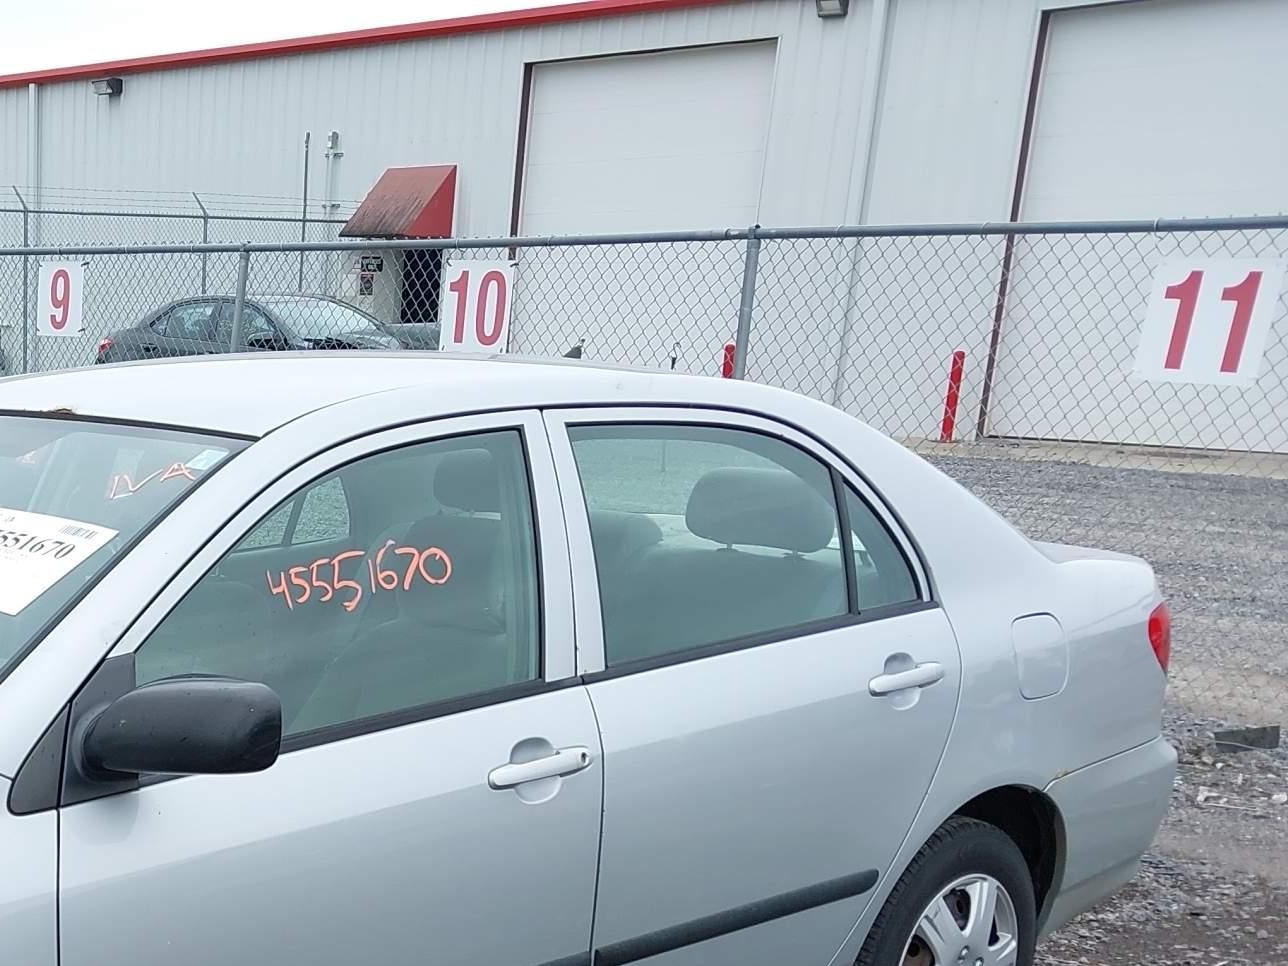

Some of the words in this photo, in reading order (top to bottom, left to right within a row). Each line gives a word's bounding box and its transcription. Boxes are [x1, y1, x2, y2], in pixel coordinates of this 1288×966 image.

[50, 269, 70, 330] 9
[449, 270, 507, 346] 10
[1164, 270, 1263, 373] 11
[267, 539, 452, 611] 45551670
